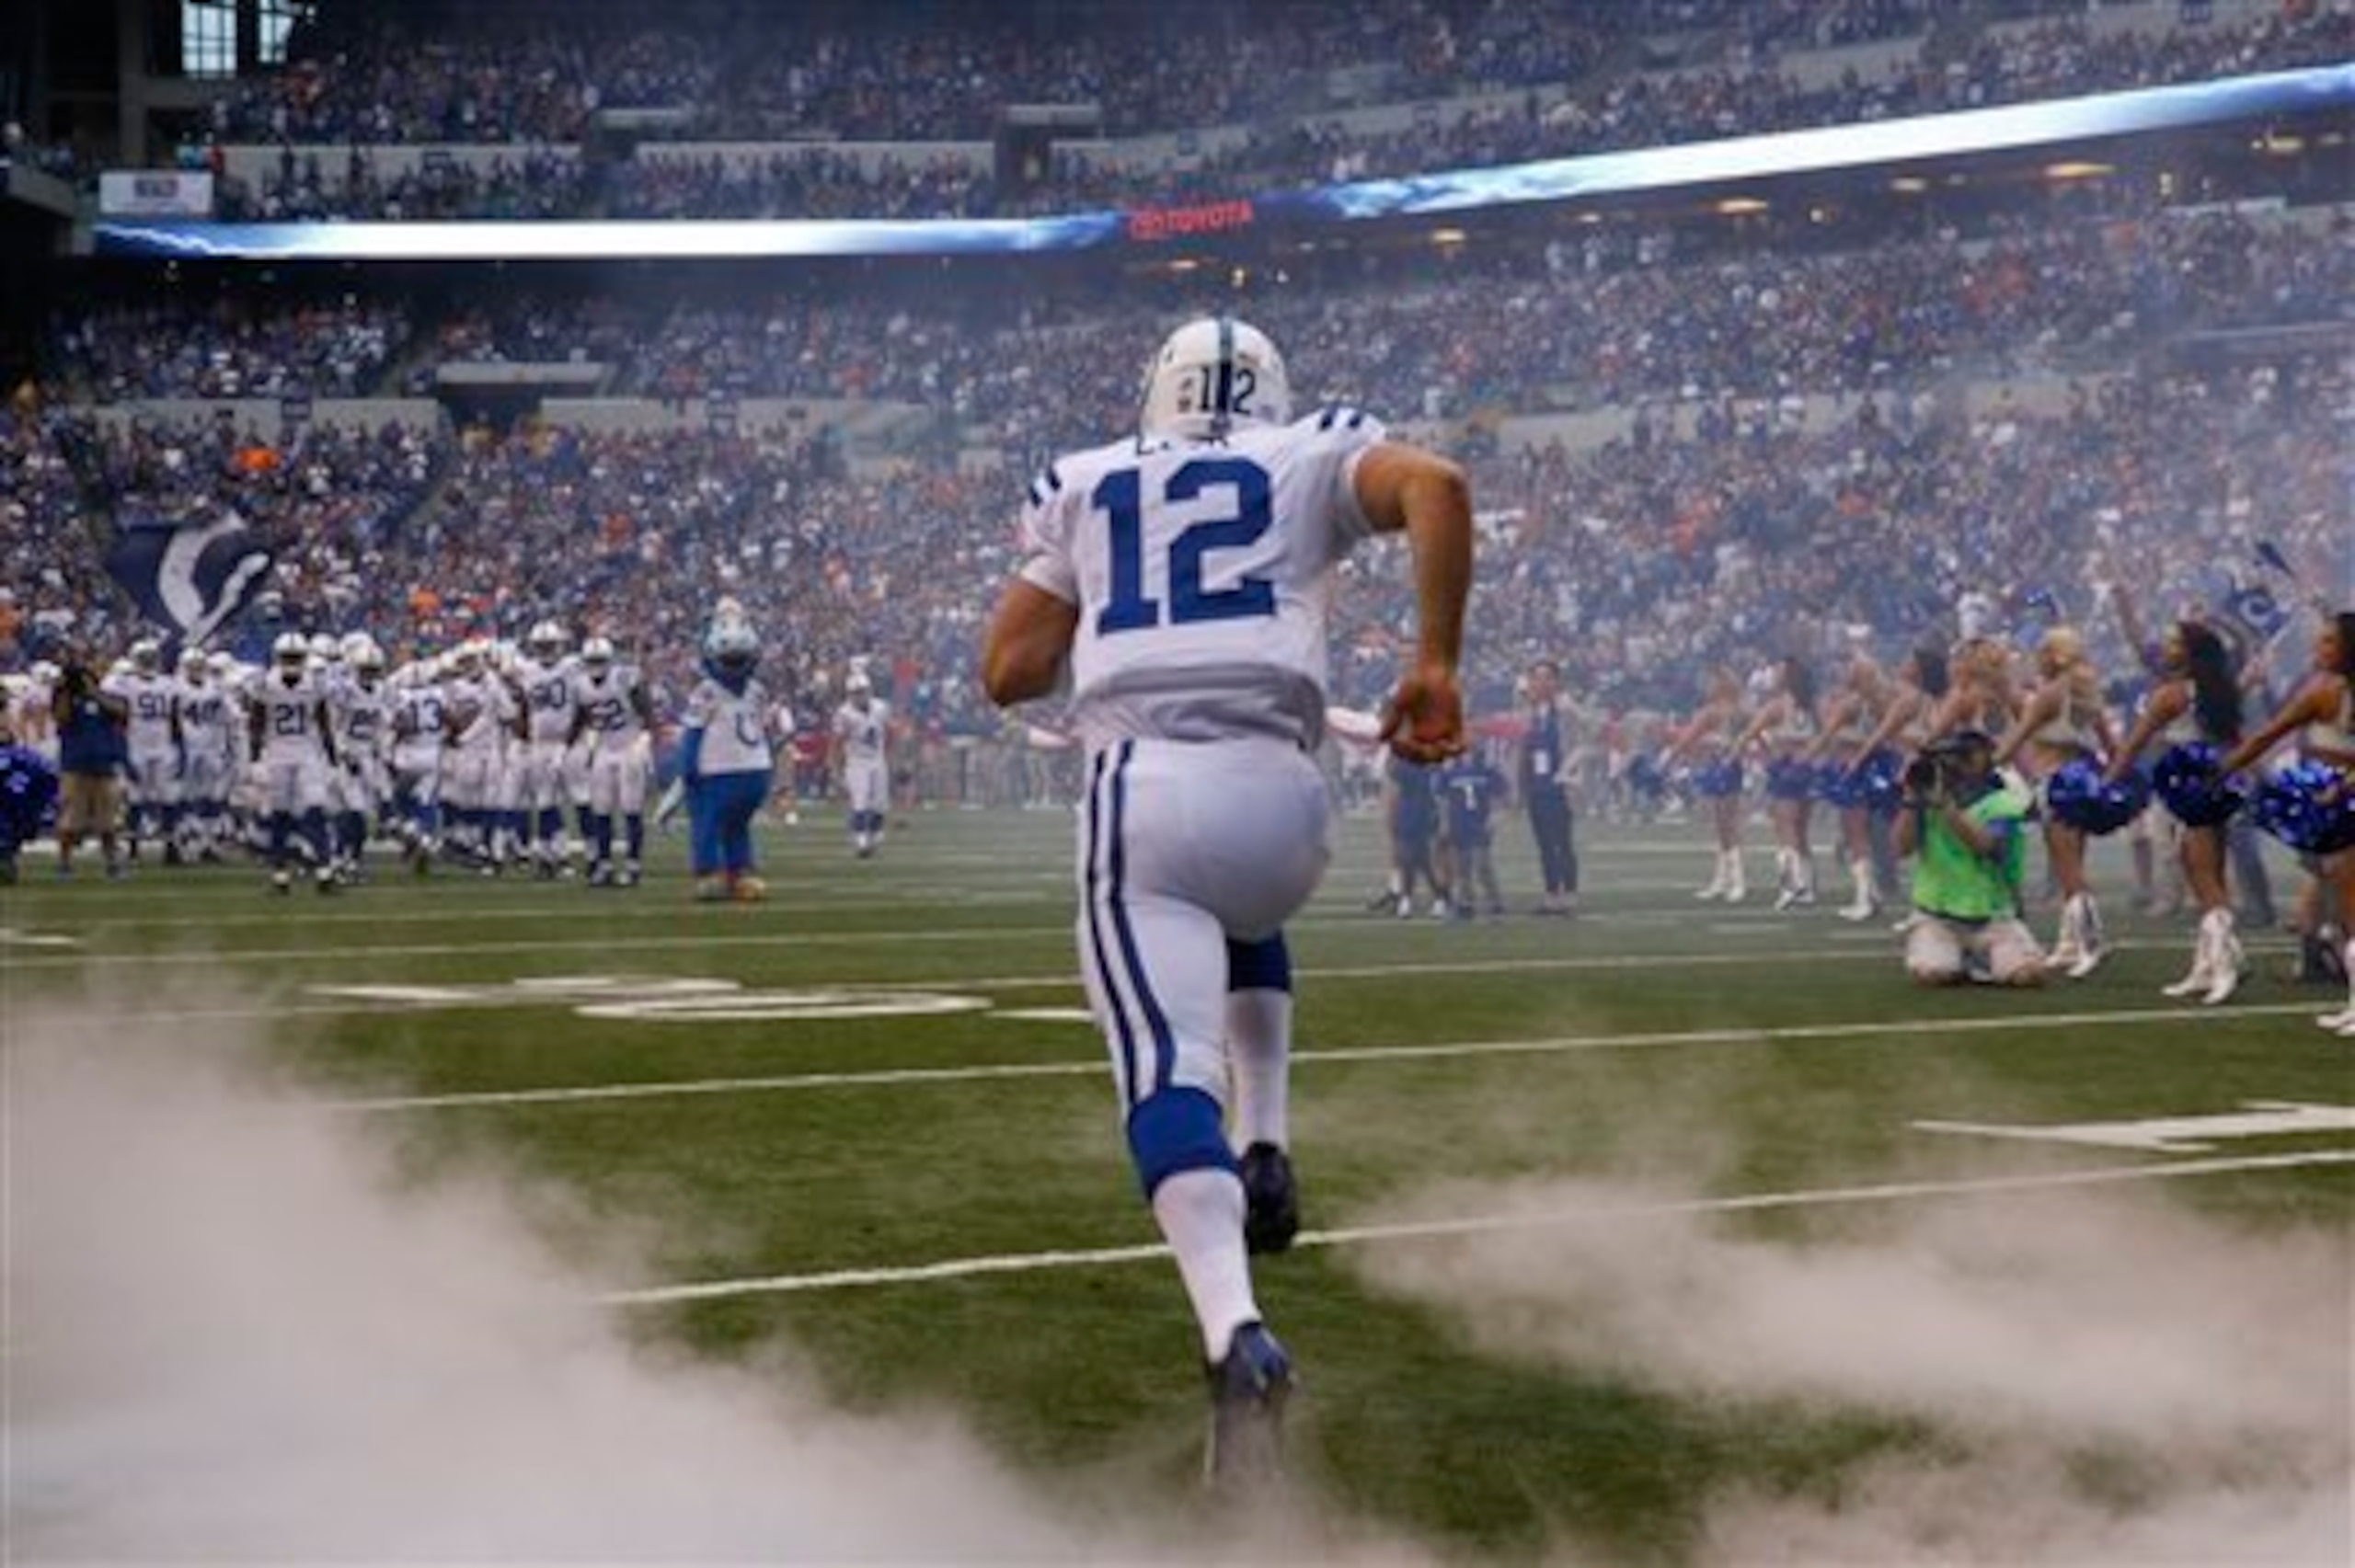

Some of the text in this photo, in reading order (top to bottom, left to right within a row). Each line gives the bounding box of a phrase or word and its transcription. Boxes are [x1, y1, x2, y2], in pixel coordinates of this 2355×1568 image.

[1166, 200, 1253, 232] TOYOTA
[1199, 363, 1257, 416] 12
[1091, 456, 1276, 635] 12
[275, 703, 306, 736] 21
